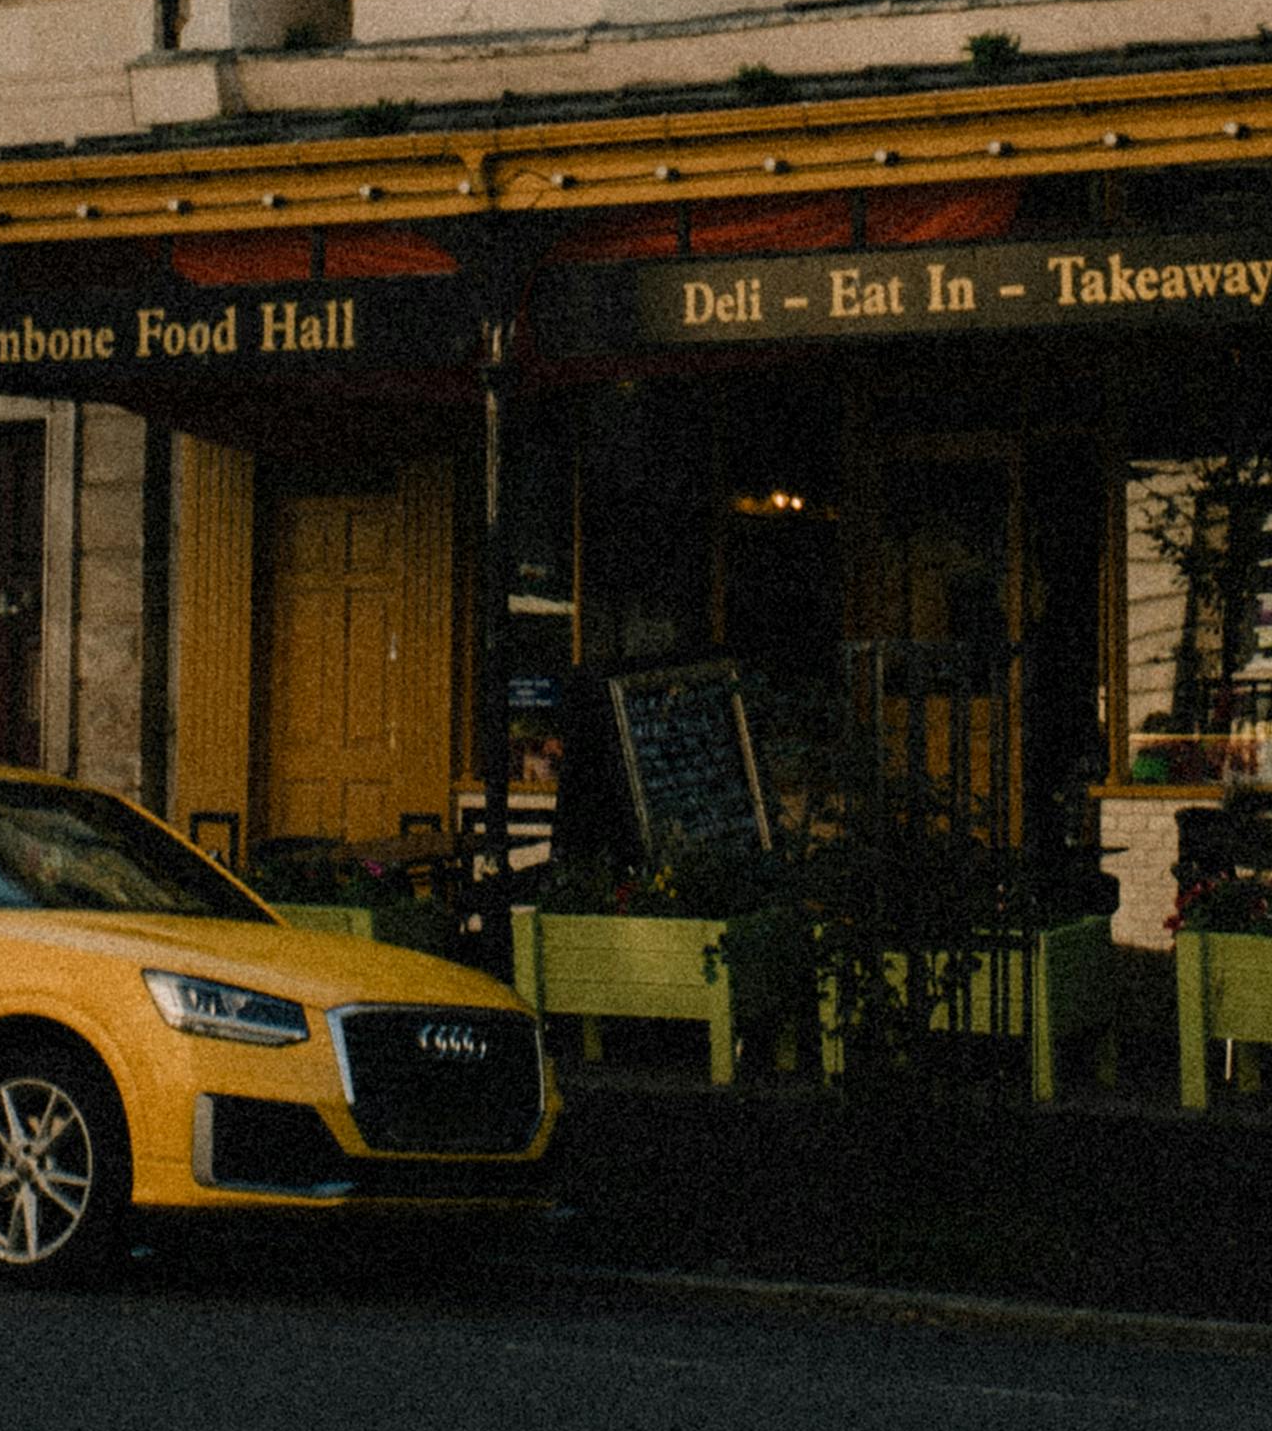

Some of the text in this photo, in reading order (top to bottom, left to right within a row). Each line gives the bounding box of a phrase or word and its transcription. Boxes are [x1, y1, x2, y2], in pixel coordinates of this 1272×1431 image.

[682, 280, 762, 325] Deli
[829, 269, 905, 319] Eat
[926, 264, 976, 313] In
[136, 305, 237, 359] Food
[260, 299, 356, 353] Hall
